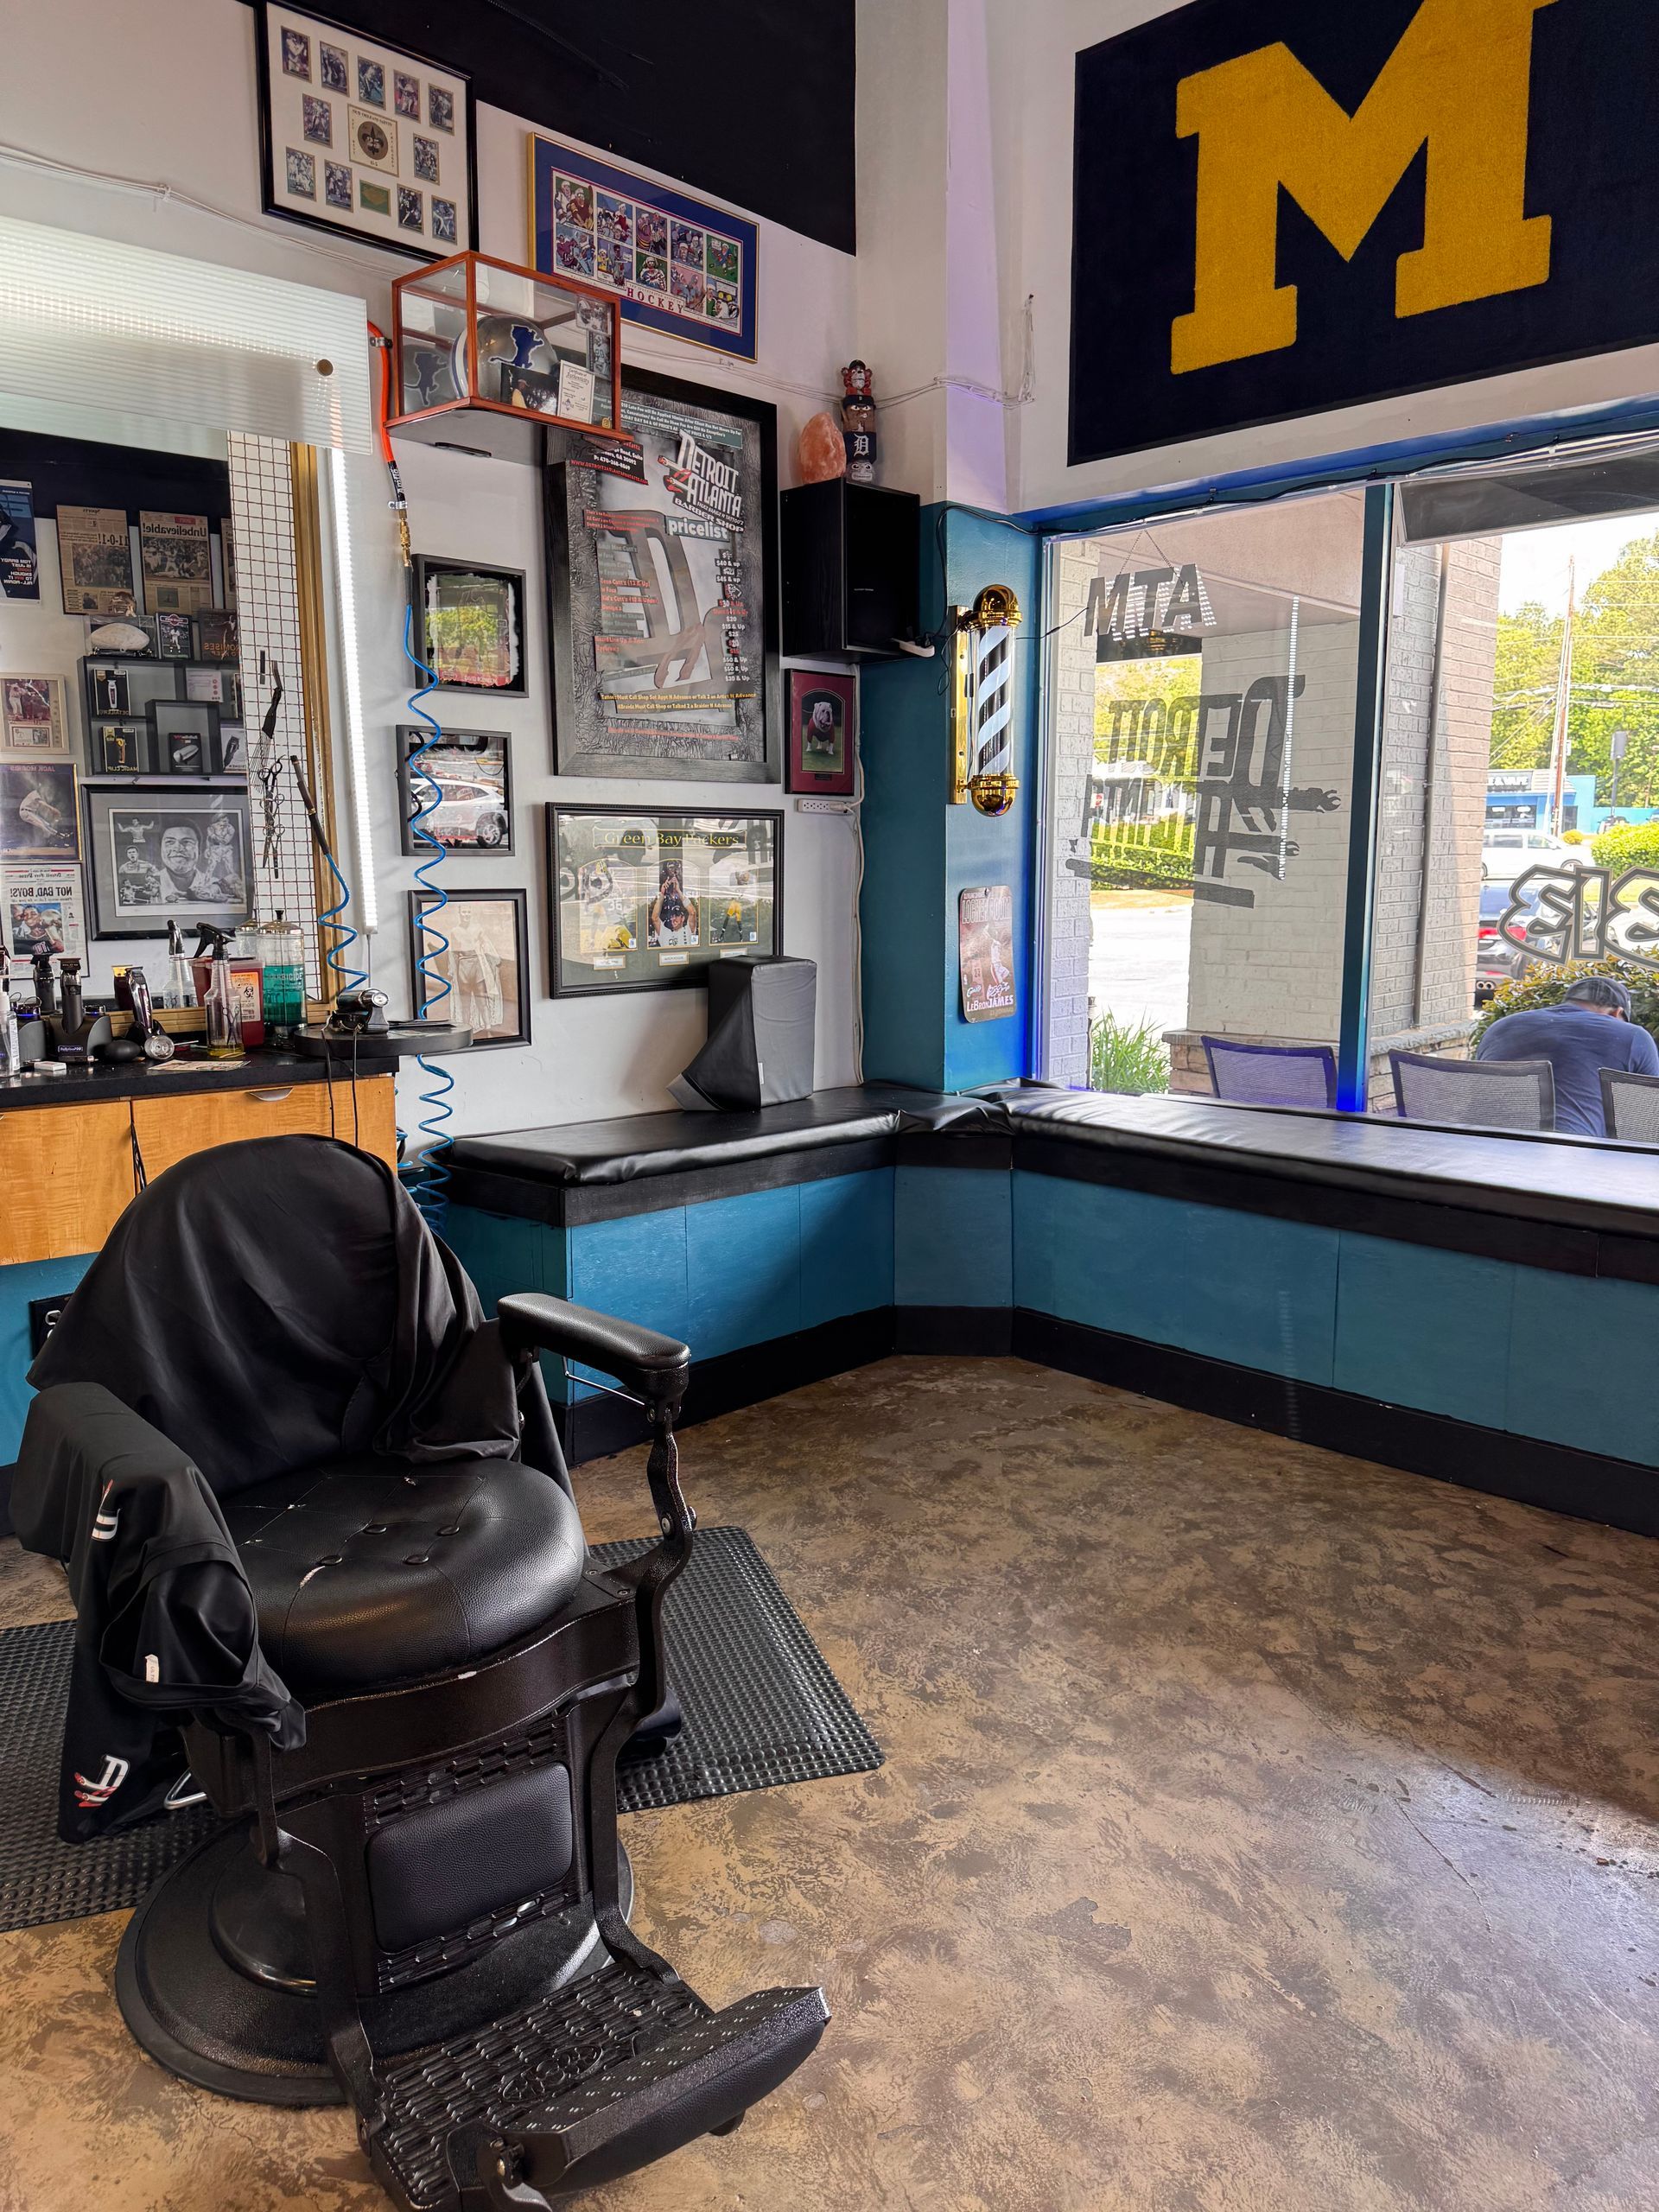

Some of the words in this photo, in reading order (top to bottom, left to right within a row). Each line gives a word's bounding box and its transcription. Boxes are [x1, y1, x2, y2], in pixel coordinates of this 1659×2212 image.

[1170, 0, 1561, 375] M
[626, 287, 683, 314] HOCKEY
[854, 433, 869, 457] D
[677, 429, 739, 493] DETROIT
[687, 474, 743, 518] ATLANTA
[674, 498, 715, 524] BARBER
[715, 518, 744, 533] SHOP
[668, 518, 728, 541] pricelist
[604, 831, 651, 845] Green
[657, 832, 683, 848] Bay
[685, 832, 740, 846] Packers
[988, 995, 1014, 1007] JAMES
